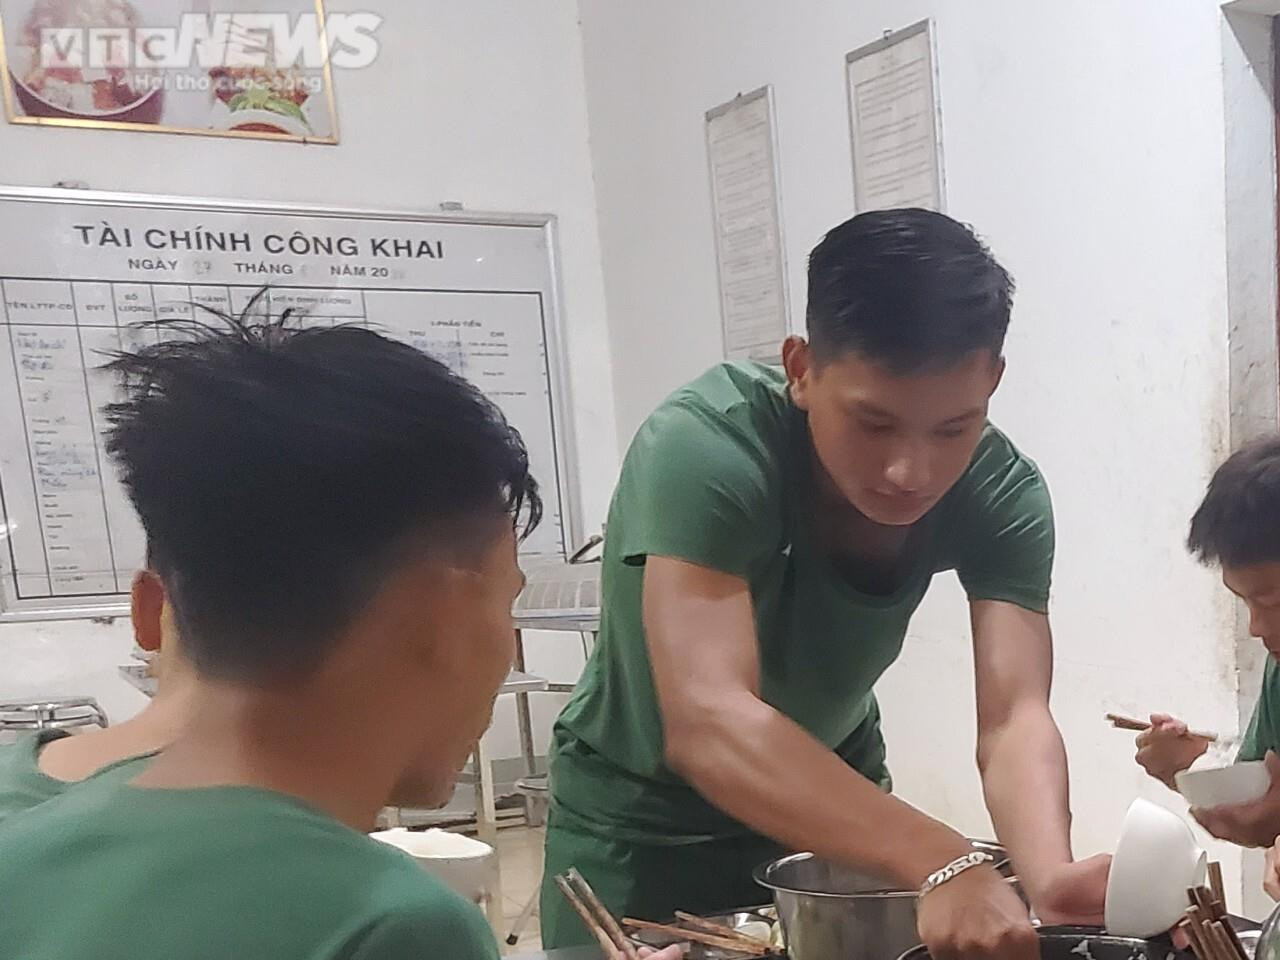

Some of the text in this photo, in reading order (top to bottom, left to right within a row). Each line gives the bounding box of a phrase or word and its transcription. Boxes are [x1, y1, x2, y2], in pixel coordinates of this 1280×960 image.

[74, 221, 444, 259] TÀI CHÍNH CÔNG KHAI
[128, 256, 178, 271] NGÀY
[234, 261, 294, 275] THÁNG
[371, 267, 388, 277] 20
